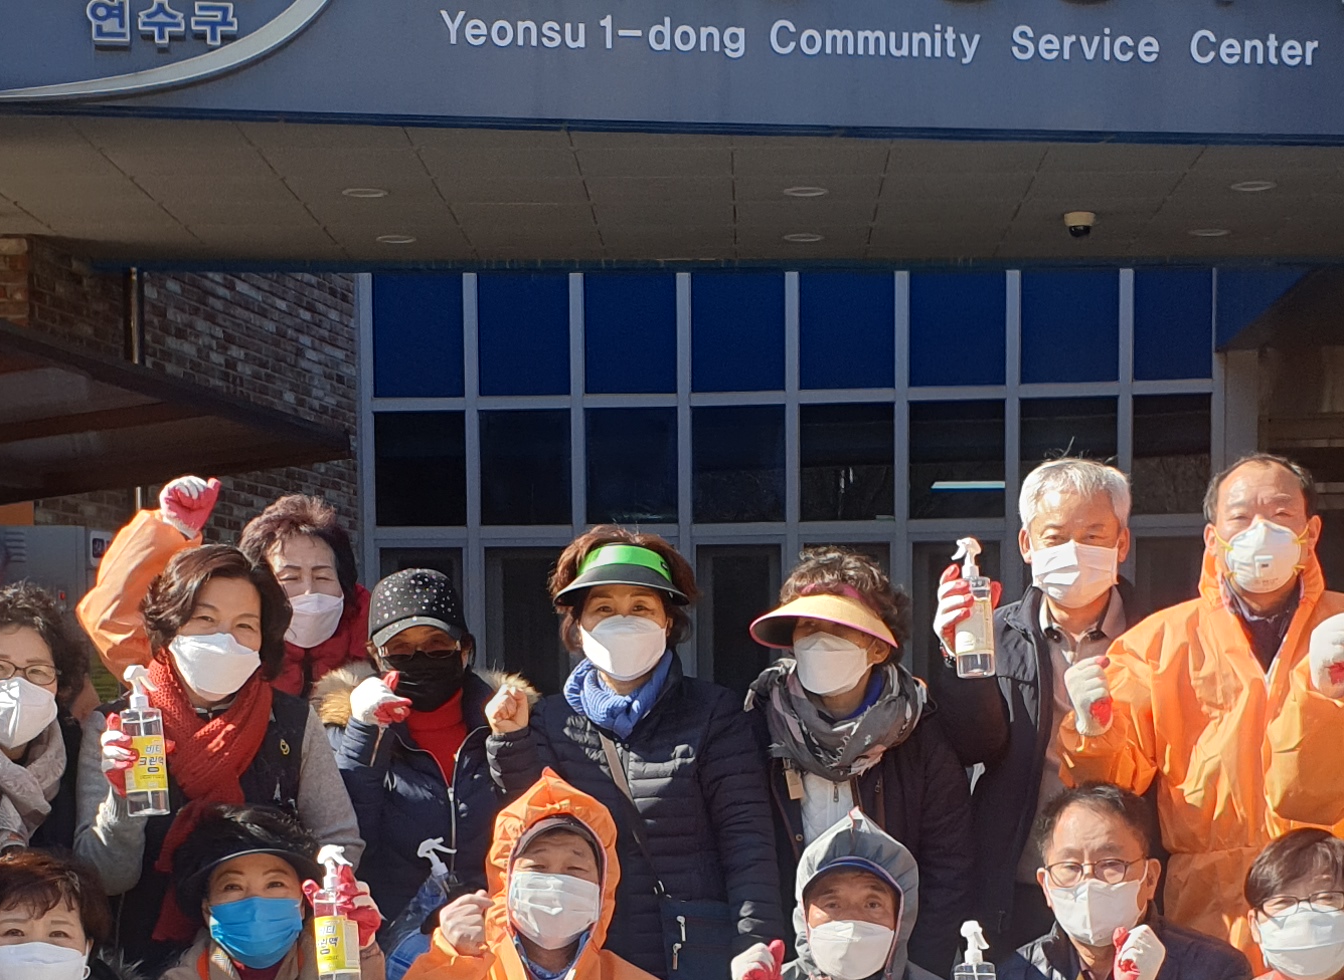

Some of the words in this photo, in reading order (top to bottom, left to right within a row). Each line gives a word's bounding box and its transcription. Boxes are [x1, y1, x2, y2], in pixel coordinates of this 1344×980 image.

[87, 0, 238, 47] 연수구
[439, 10, 586, 49] Yeonsu
[599, 14, 747, 59] 1-dong
[769, 19, 981, 64] Community
[1011, 24, 1160, 62] Service
[1189, 29, 1319, 66] Center
